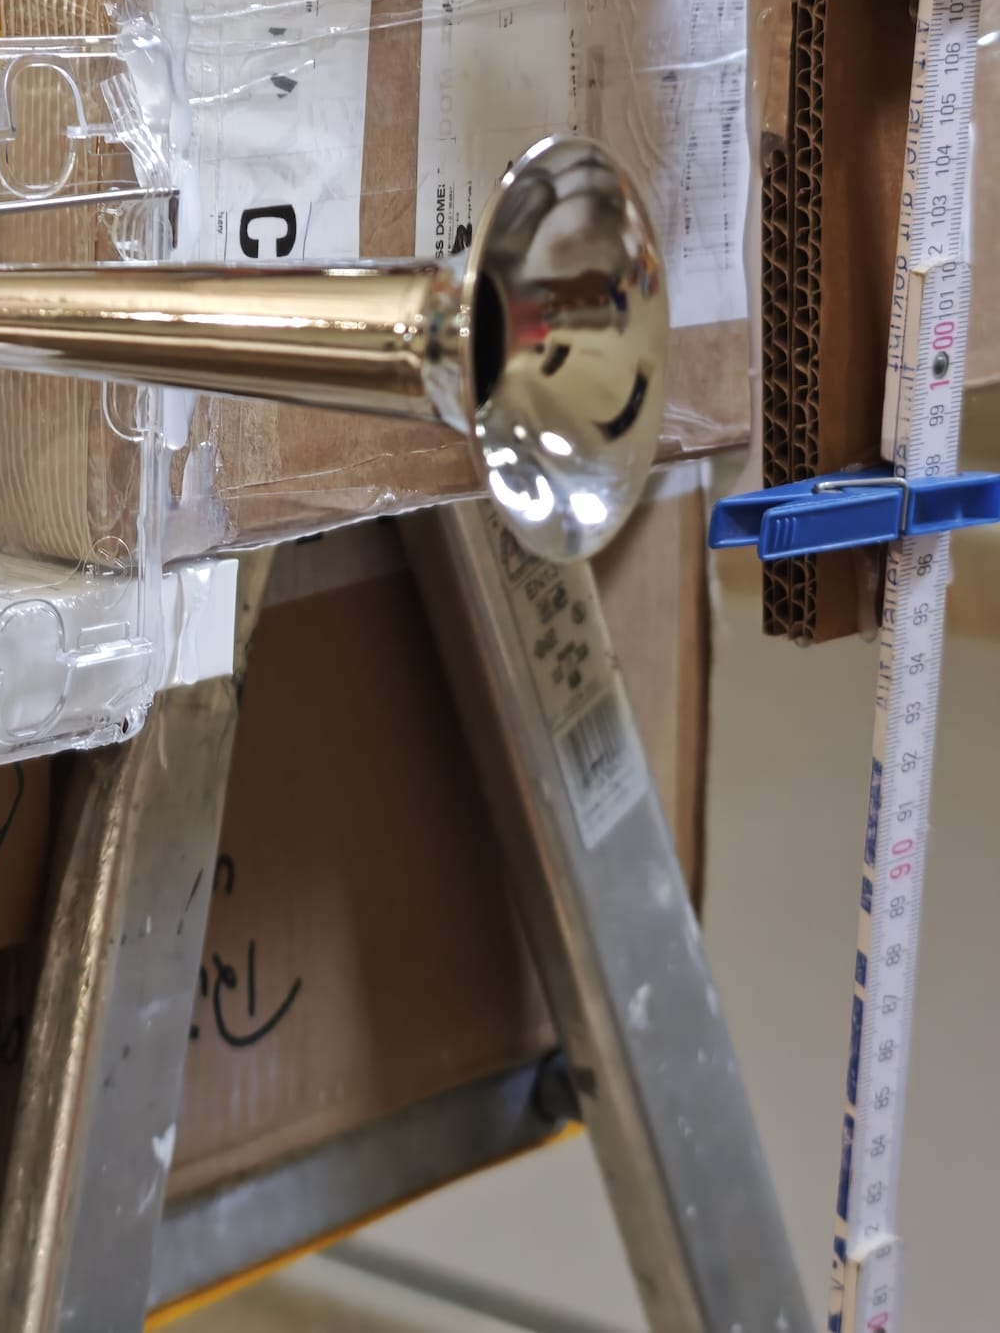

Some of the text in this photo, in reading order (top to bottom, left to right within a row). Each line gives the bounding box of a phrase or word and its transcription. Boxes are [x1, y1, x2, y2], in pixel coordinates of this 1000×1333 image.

[943, 42, 961, 75] 106
[938, 93, 957, 126] 105
[935, 144, 953, 177] 104
[930, 194, 948, 227] 103
[239, 204, 298, 258] C
[938, 289, 956, 321] 101
[928, 403, 945, 428] 99
[916, 553, 933, 577] 96
[911, 603, 929, 626] 95
[908, 652, 925, 675] 94
[904, 701, 921, 724] 93
[900, 750, 917, 773] 92
[896, 801, 914, 823] 91
[888, 838, 916, 880] 90
[890, 895, 907, 919] 89
[885, 943, 902, 968] 88
[881, 994, 899, 1016] 87
[877, 1038, 895, 1063] 86
[873, 1086, 891, 1111] 85
[869, 1134, 887, 1159] 84
[865, 1181, 883, 1206] 83
[872, 1285, 890, 1307] 81
